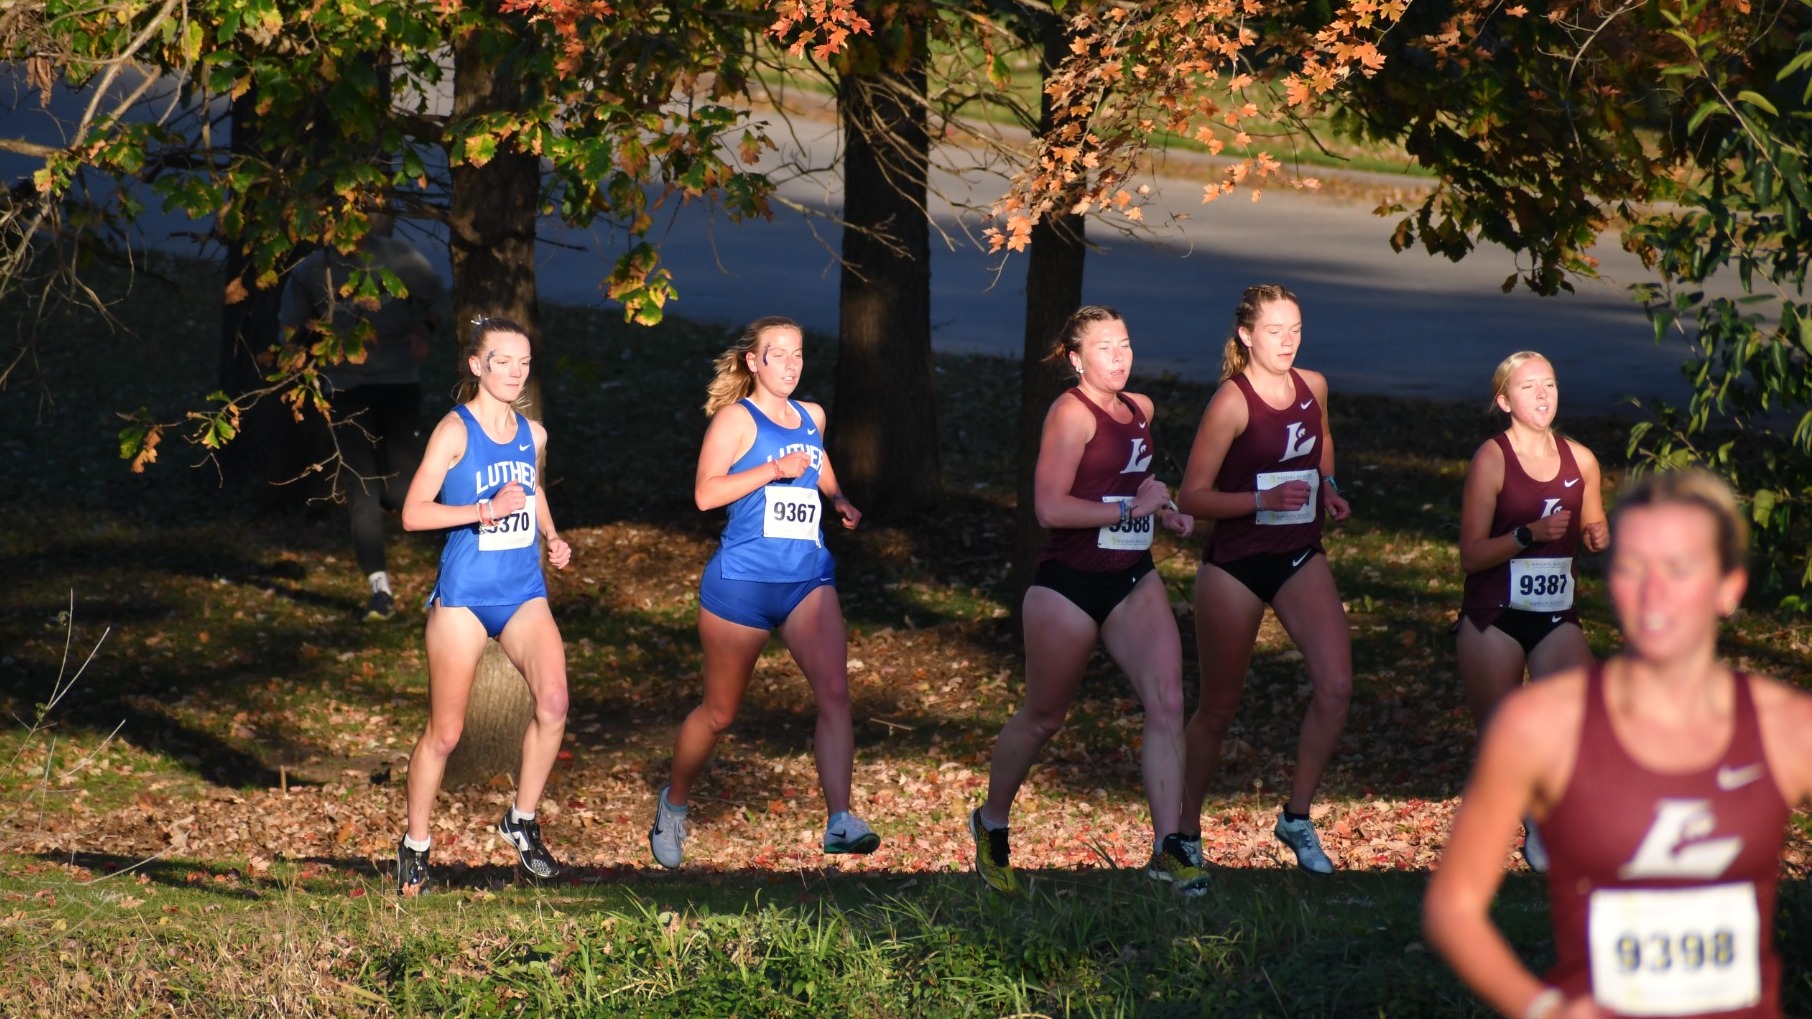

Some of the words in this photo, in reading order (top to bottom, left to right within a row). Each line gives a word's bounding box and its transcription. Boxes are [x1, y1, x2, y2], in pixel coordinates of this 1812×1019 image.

[767, 443, 823, 475] TER
[476, 461, 536, 495] LUTHER
[774, 502, 816, 523] 9367
[1520, 574, 1567, 596] 9387
[1615, 927, 1734, 973] 9398
